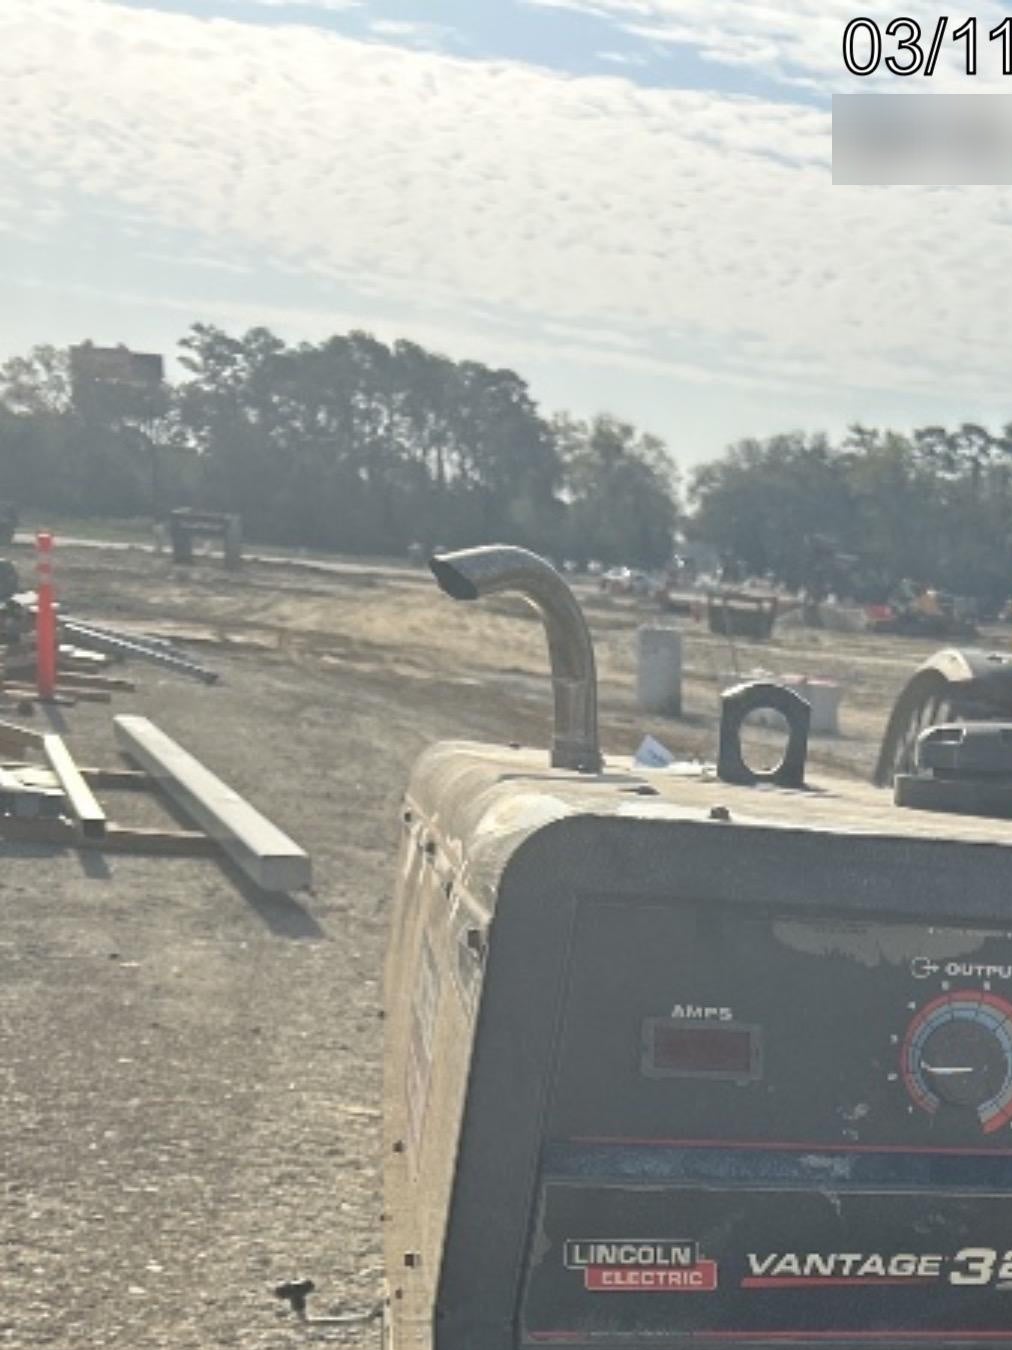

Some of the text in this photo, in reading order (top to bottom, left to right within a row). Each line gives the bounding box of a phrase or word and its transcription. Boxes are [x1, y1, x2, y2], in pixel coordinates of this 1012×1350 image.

[671, 1004, 733, 1021] AMPS
[573, 1244, 691, 1265] LINCOLN
[747, 1253, 942, 1277] VANTAGE
[601, 1271, 704, 1285] ELECTRIC
